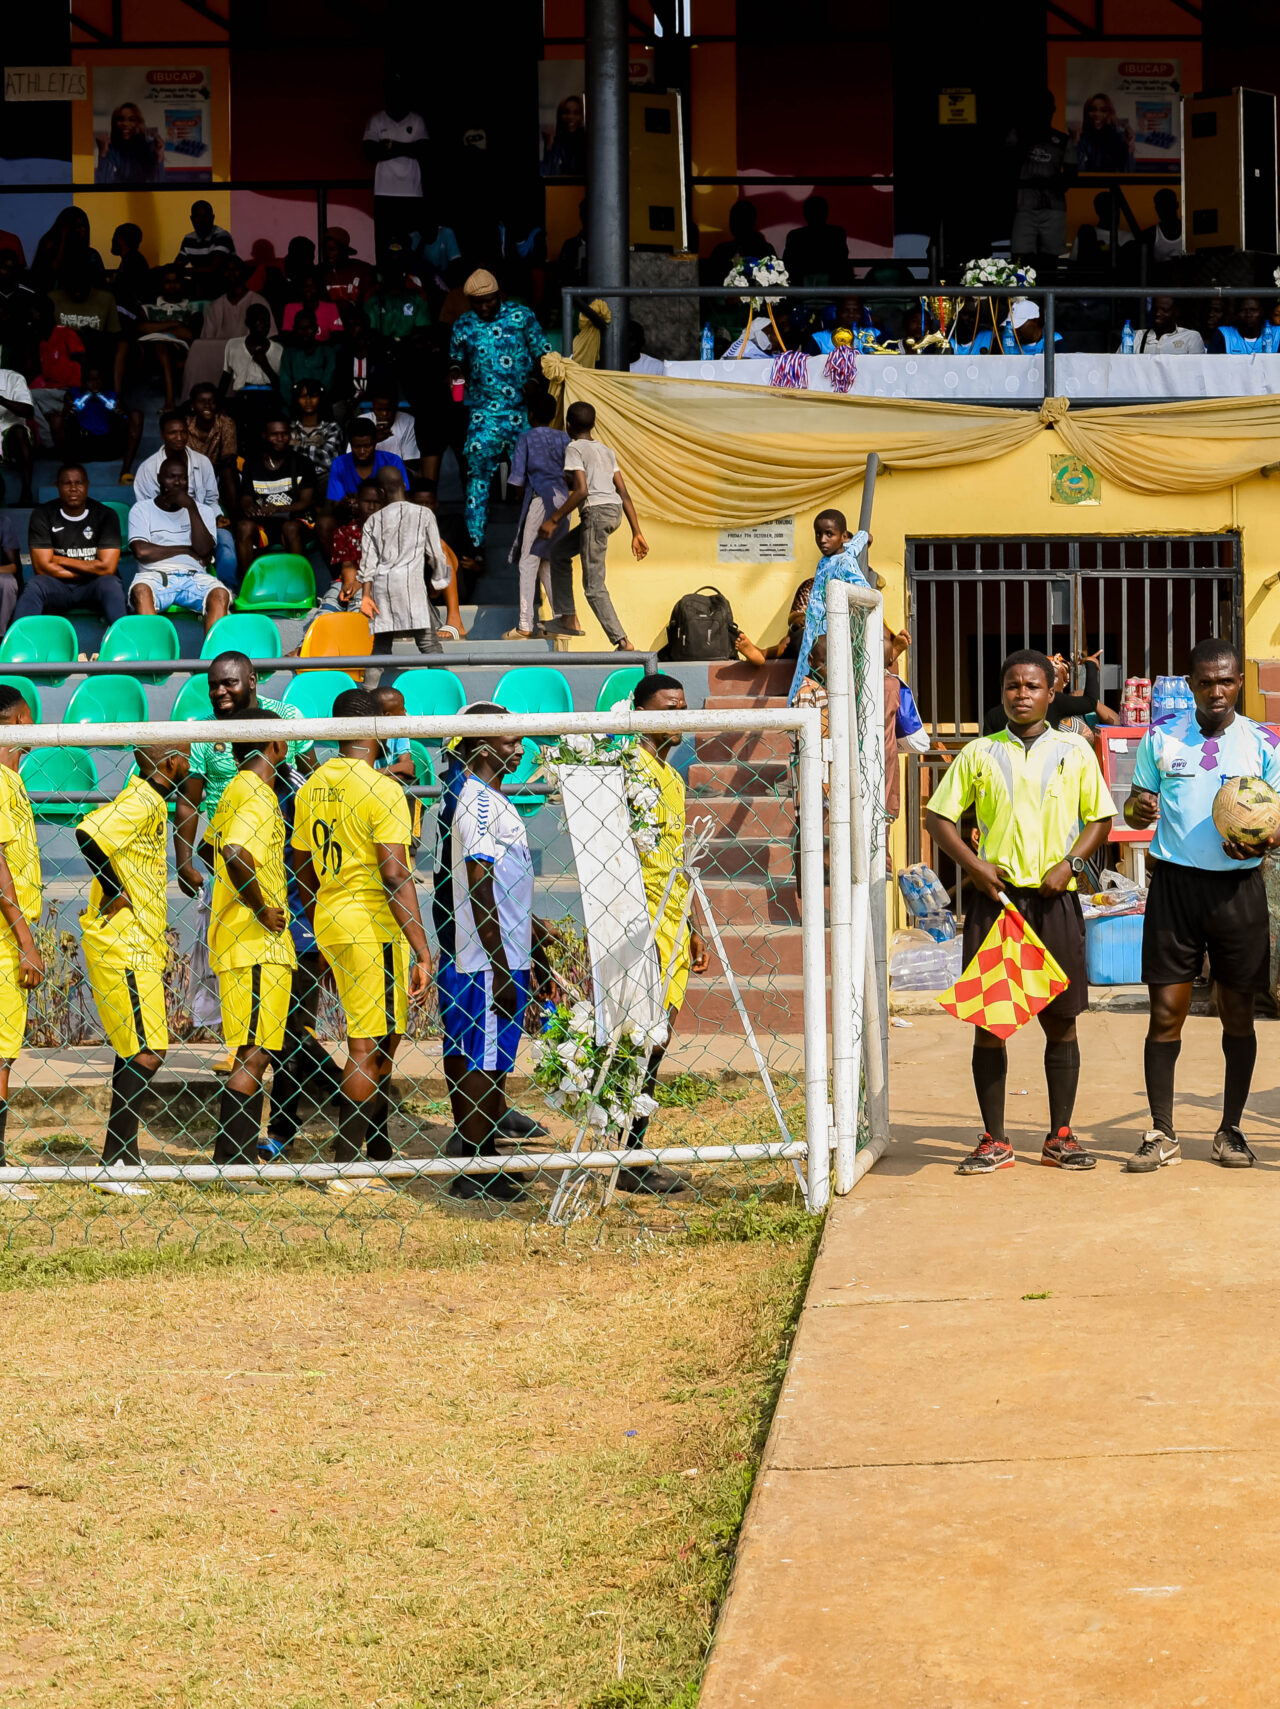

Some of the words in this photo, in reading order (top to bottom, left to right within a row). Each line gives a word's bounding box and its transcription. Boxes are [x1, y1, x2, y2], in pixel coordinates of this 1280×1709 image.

[152, 71, 197, 81] IBUCAP
[1125, 63, 1168, 73] IBUCAP
[6, 72, 86, 95] ATHLETES
[312, 818, 343, 876] 96
